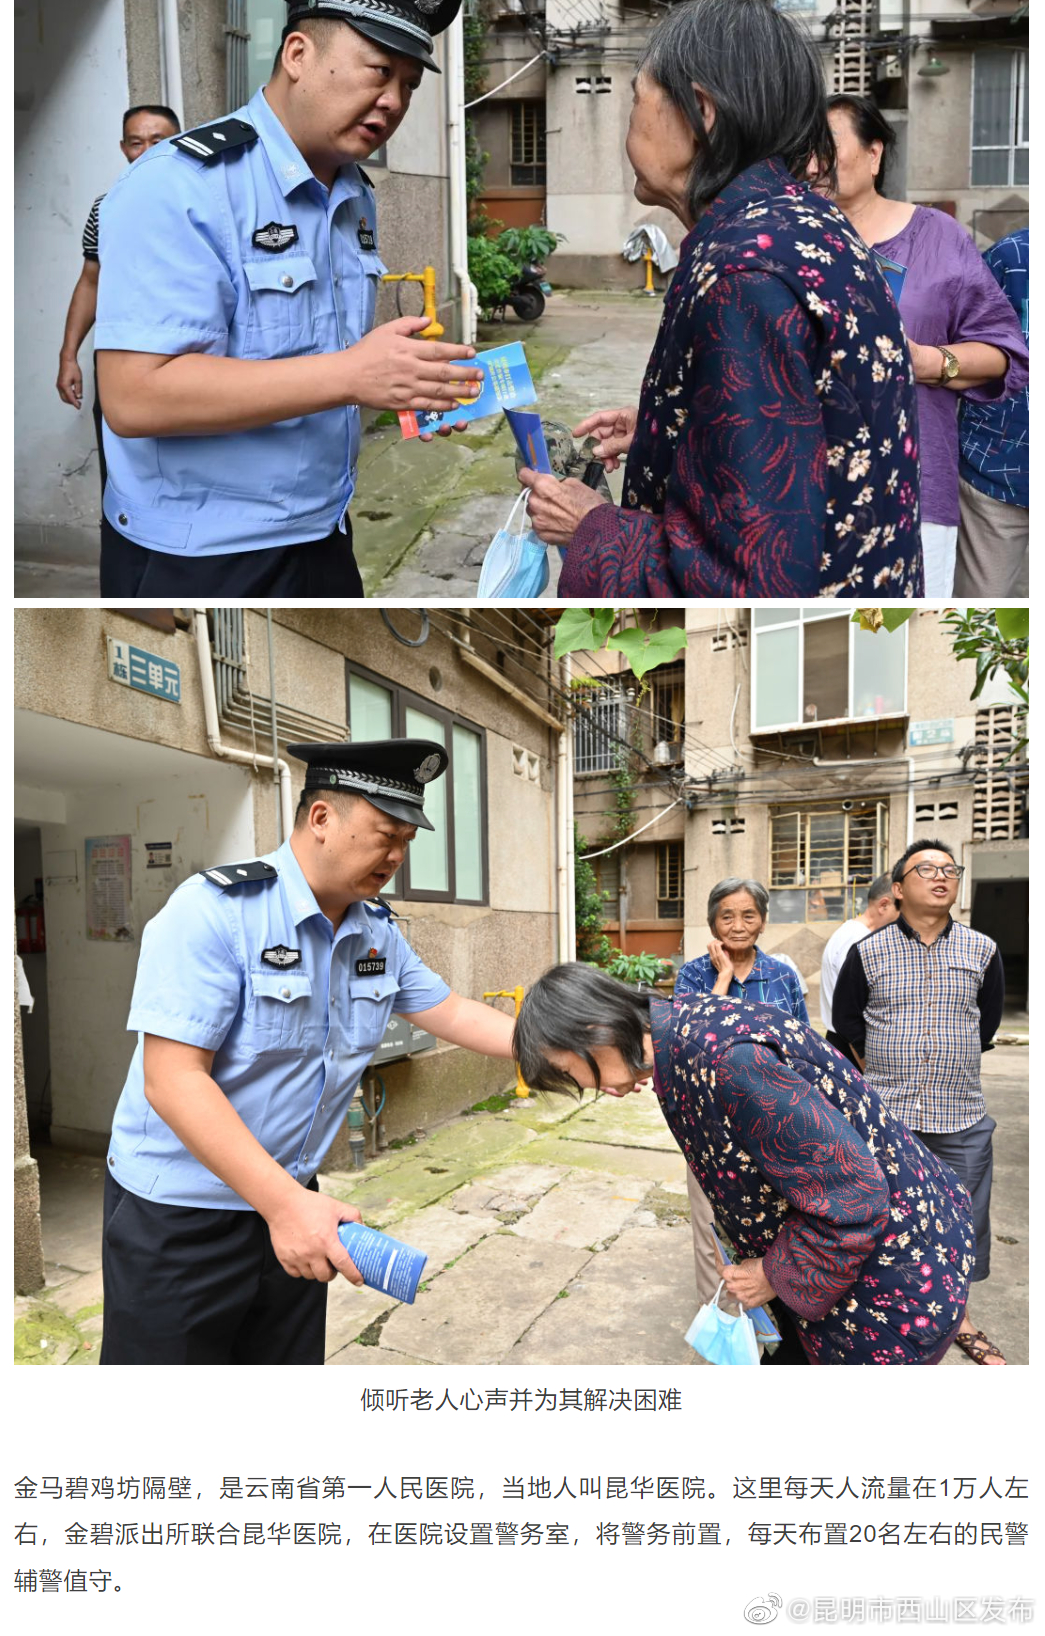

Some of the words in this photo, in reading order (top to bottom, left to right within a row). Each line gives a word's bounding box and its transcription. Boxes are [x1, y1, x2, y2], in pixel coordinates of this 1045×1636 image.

[131, 653, 178, 697] 三单元
[358, 962, 384, 972] 015739
